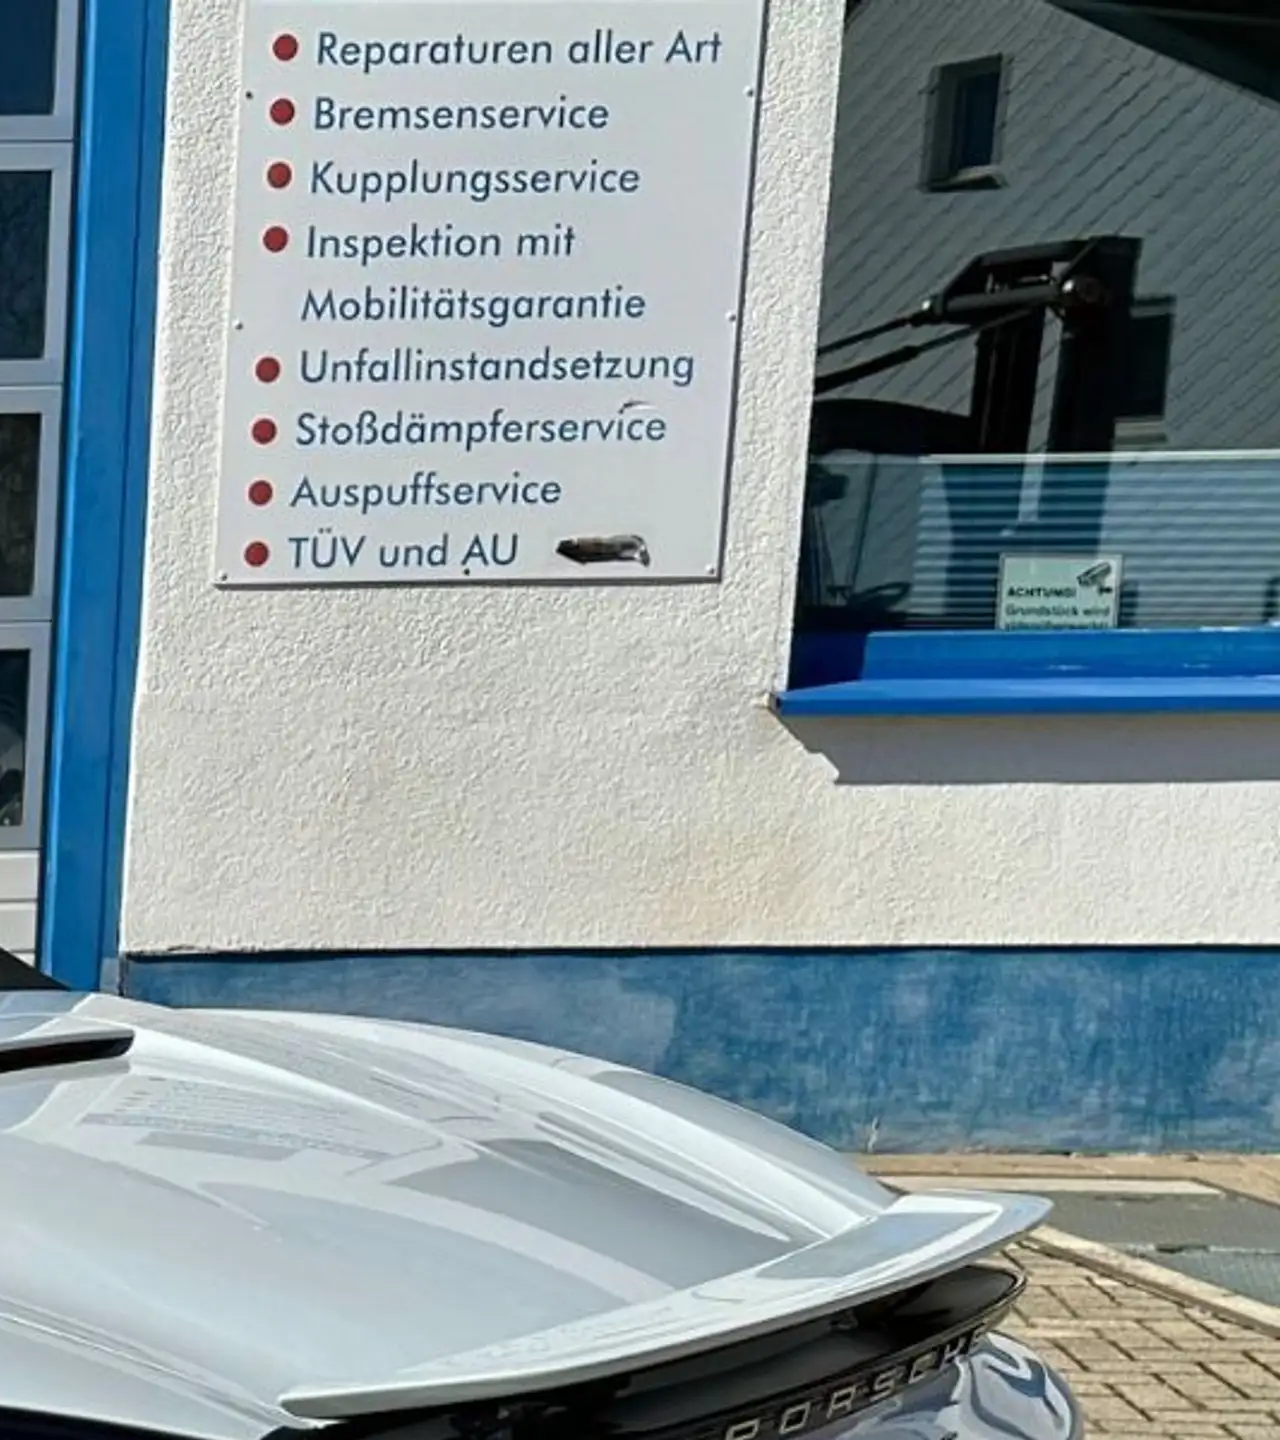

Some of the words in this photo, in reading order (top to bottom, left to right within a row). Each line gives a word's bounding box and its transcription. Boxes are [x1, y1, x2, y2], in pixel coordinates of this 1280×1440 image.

[317, 32, 552, 74] Reparaturen
[568, 29, 653, 64] aller
[666, 30, 722, 64] Art
[314, 96, 609, 130] Bremsenservice
[310, 159, 640, 203] Kupplungsservice
[306, 223, 500, 267] Inspektion
[516, 224, 576, 257] mit
[300, 284, 646, 327] Mobilitätsgarantie
[299, 346, 695, 388] Unfallinstandsetzung
[296, 408, 667, 452] Stoßdämpferservice
[290, 470, 562, 515] Auspuffservice
[289, 527, 365, 568] TÜV
[379, 533, 449, 567] und
[462, 533, 518, 567] AU
